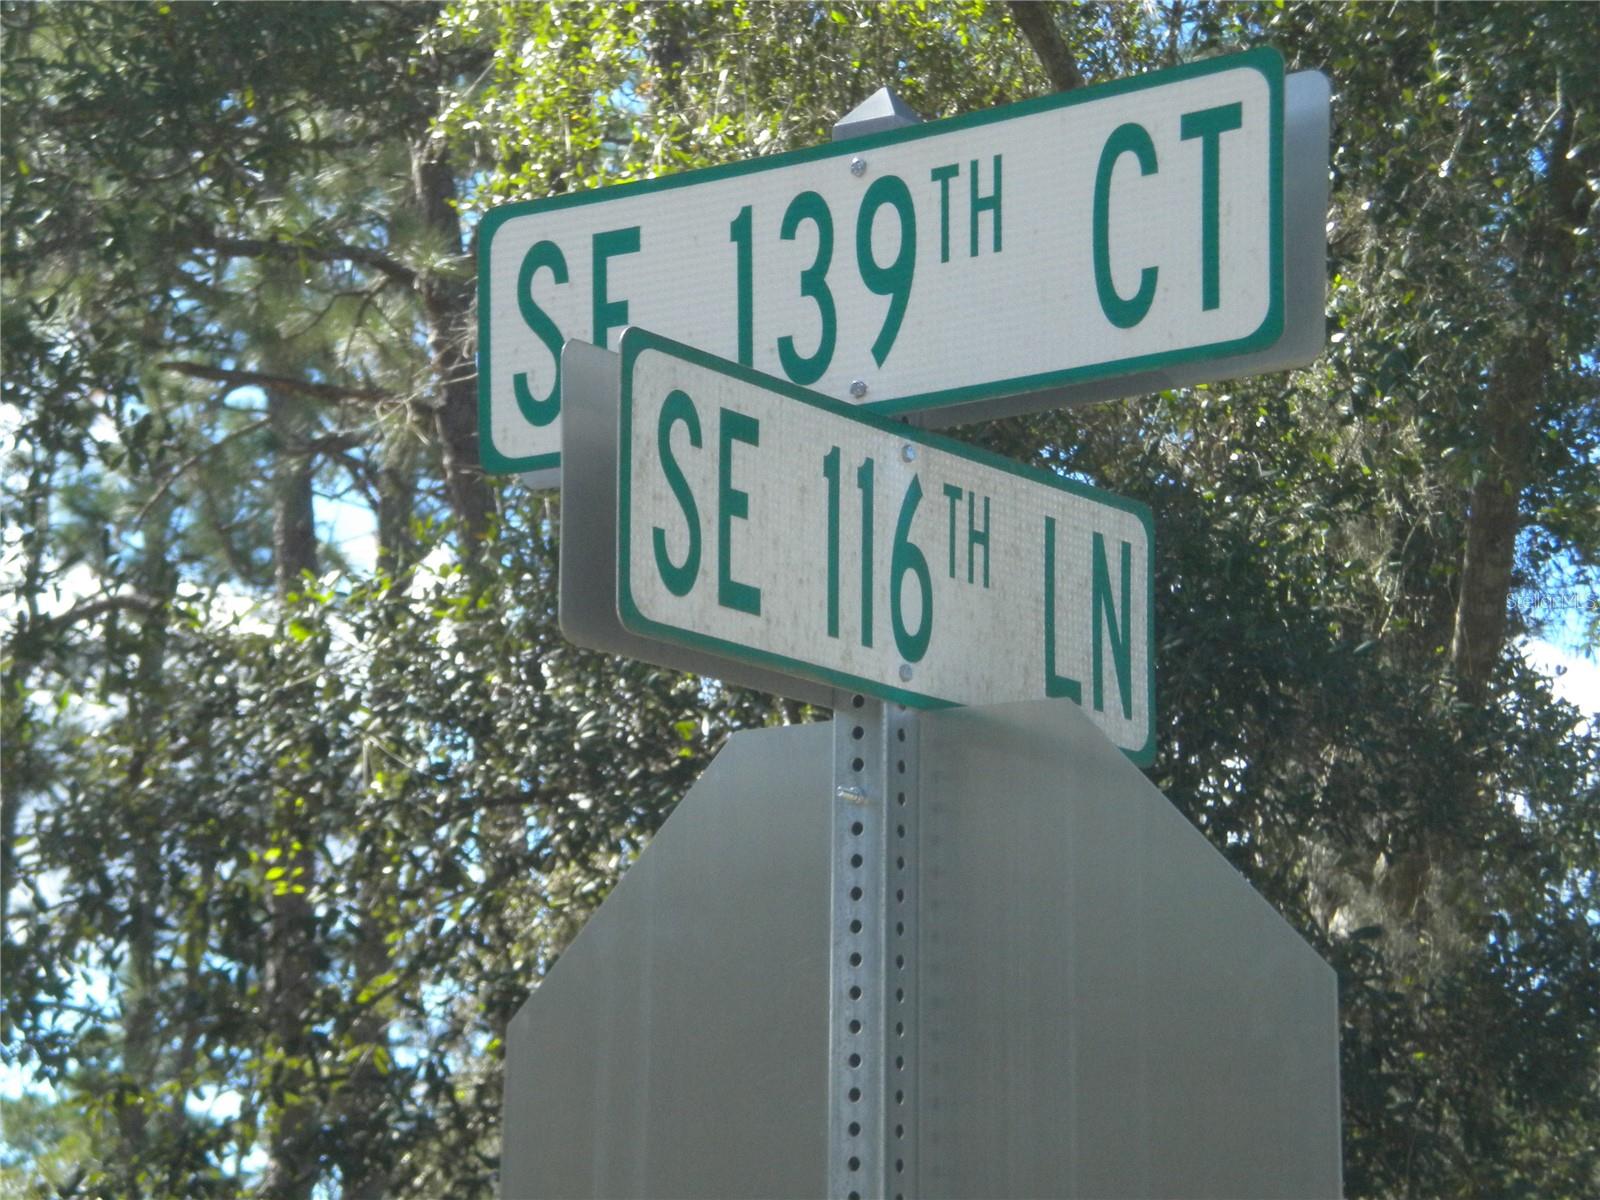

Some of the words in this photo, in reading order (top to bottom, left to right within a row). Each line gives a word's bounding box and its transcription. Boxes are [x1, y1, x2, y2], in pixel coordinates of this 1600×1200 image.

[730, 153, 1003, 386] 139TH
[1092, 101, 1243, 329] CT
[652, 389, 762, 617] SE
[822, 445, 991, 663] 116TH
[1044, 515, 1133, 721] LN
